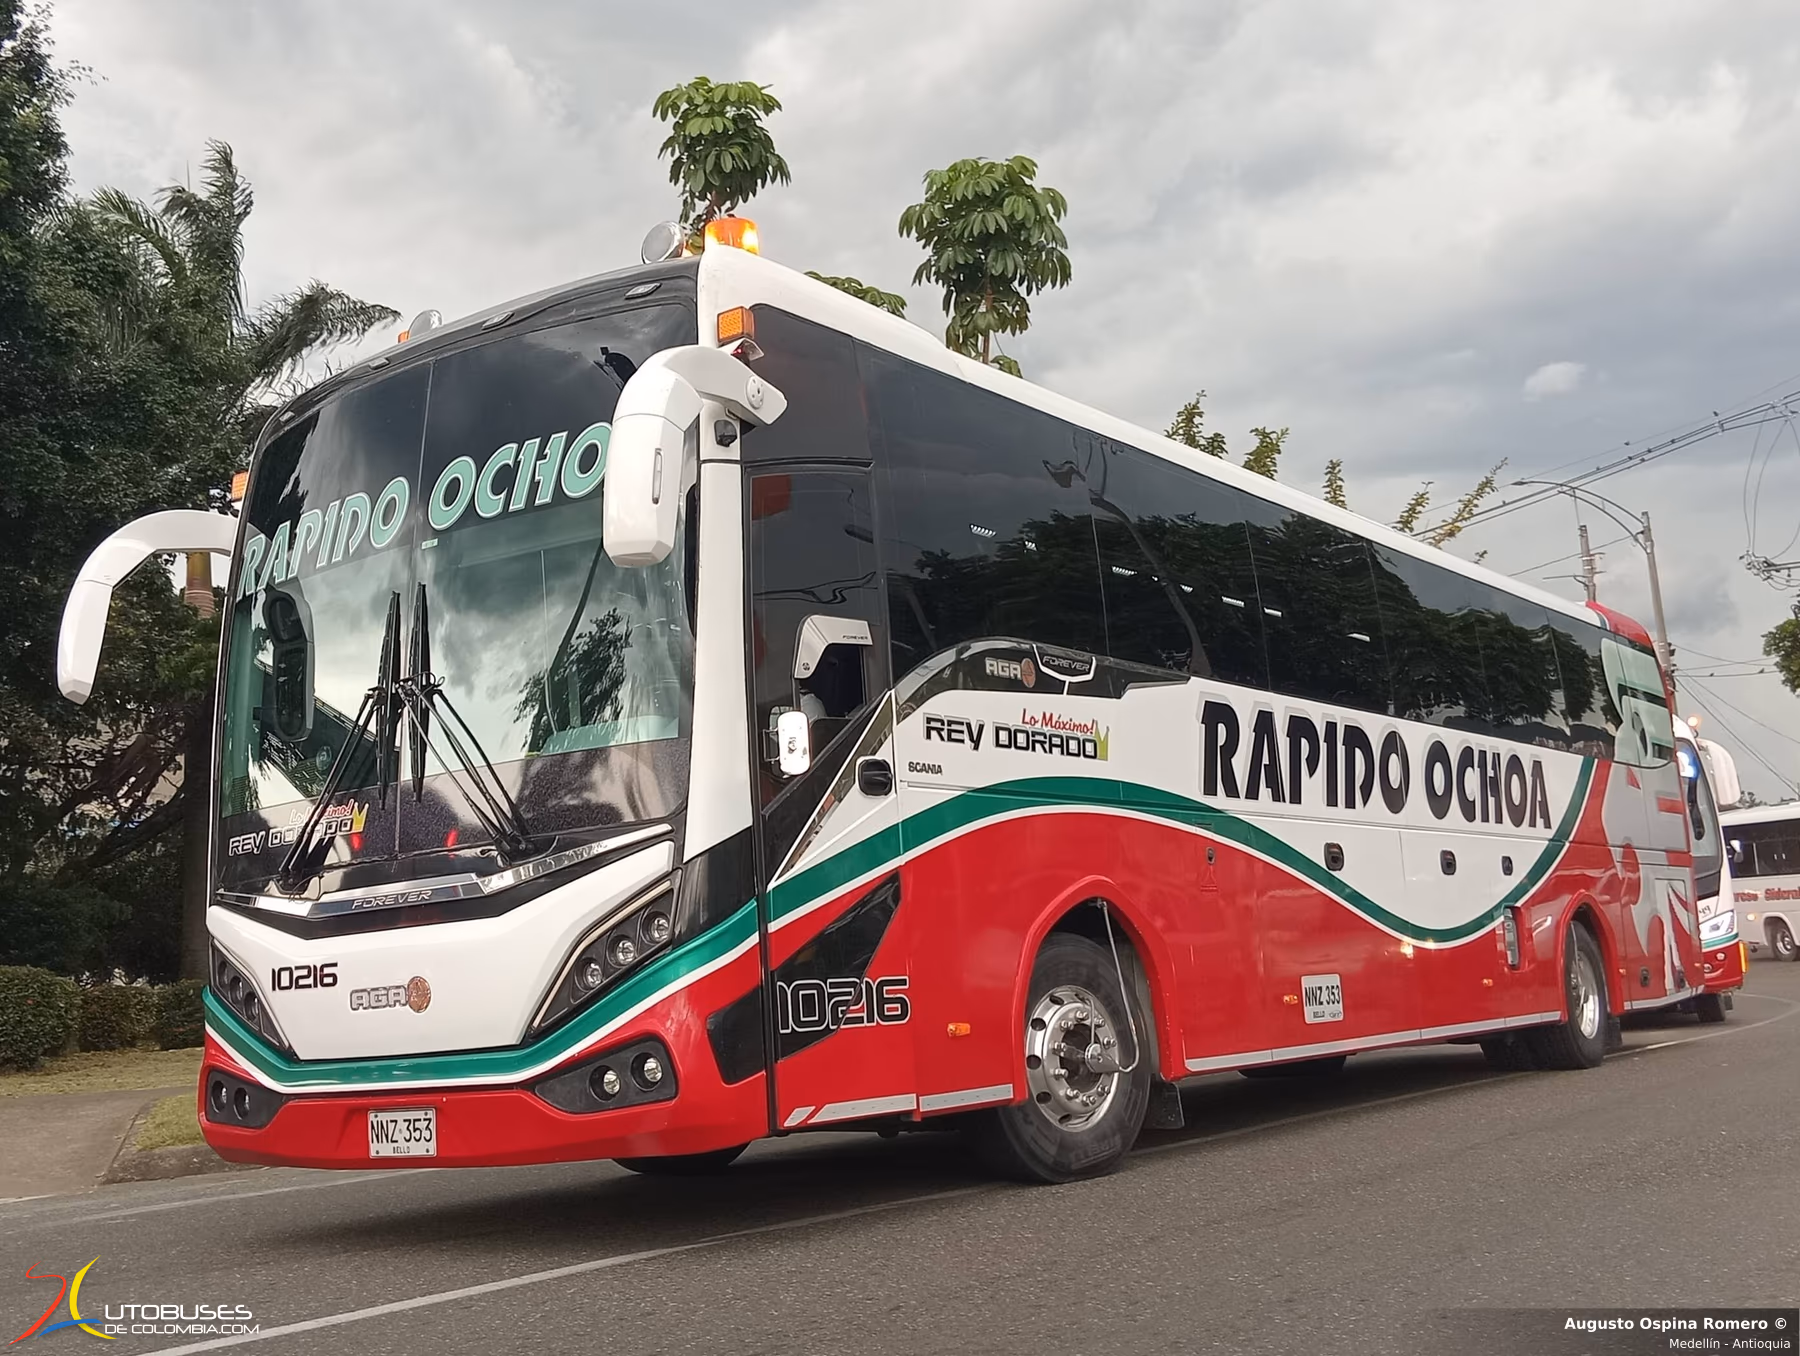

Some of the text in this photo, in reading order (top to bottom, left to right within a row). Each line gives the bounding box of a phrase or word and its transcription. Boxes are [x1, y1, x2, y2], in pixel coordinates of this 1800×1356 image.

[236, 421, 612, 603] RAPIDO OCHO
[985, 657, 1021, 680] AGA
[1043, 656, 1090, 672] FOREVER
[1021, 708, 1095, 735] Lo Máximo!
[923, 712, 1099, 759] REY DORADO
[908, 761, 943, 775] SCANIA
[1199, 696, 1552, 829] RAPIDO OCHOA
[228, 831, 265, 856] REY
[352, 890, 432, 910] FOREVER
[272, 962, 338, 991] 10216
[350, 984, 408, 1011] AGA
[777, 976, 910, 1033] 10216
[1304, 985, 1340, 1007] NNZ 353
[371, 1117, 432, 1144] NNZ 353
[393, 1146, 410, 1154] BELLO
